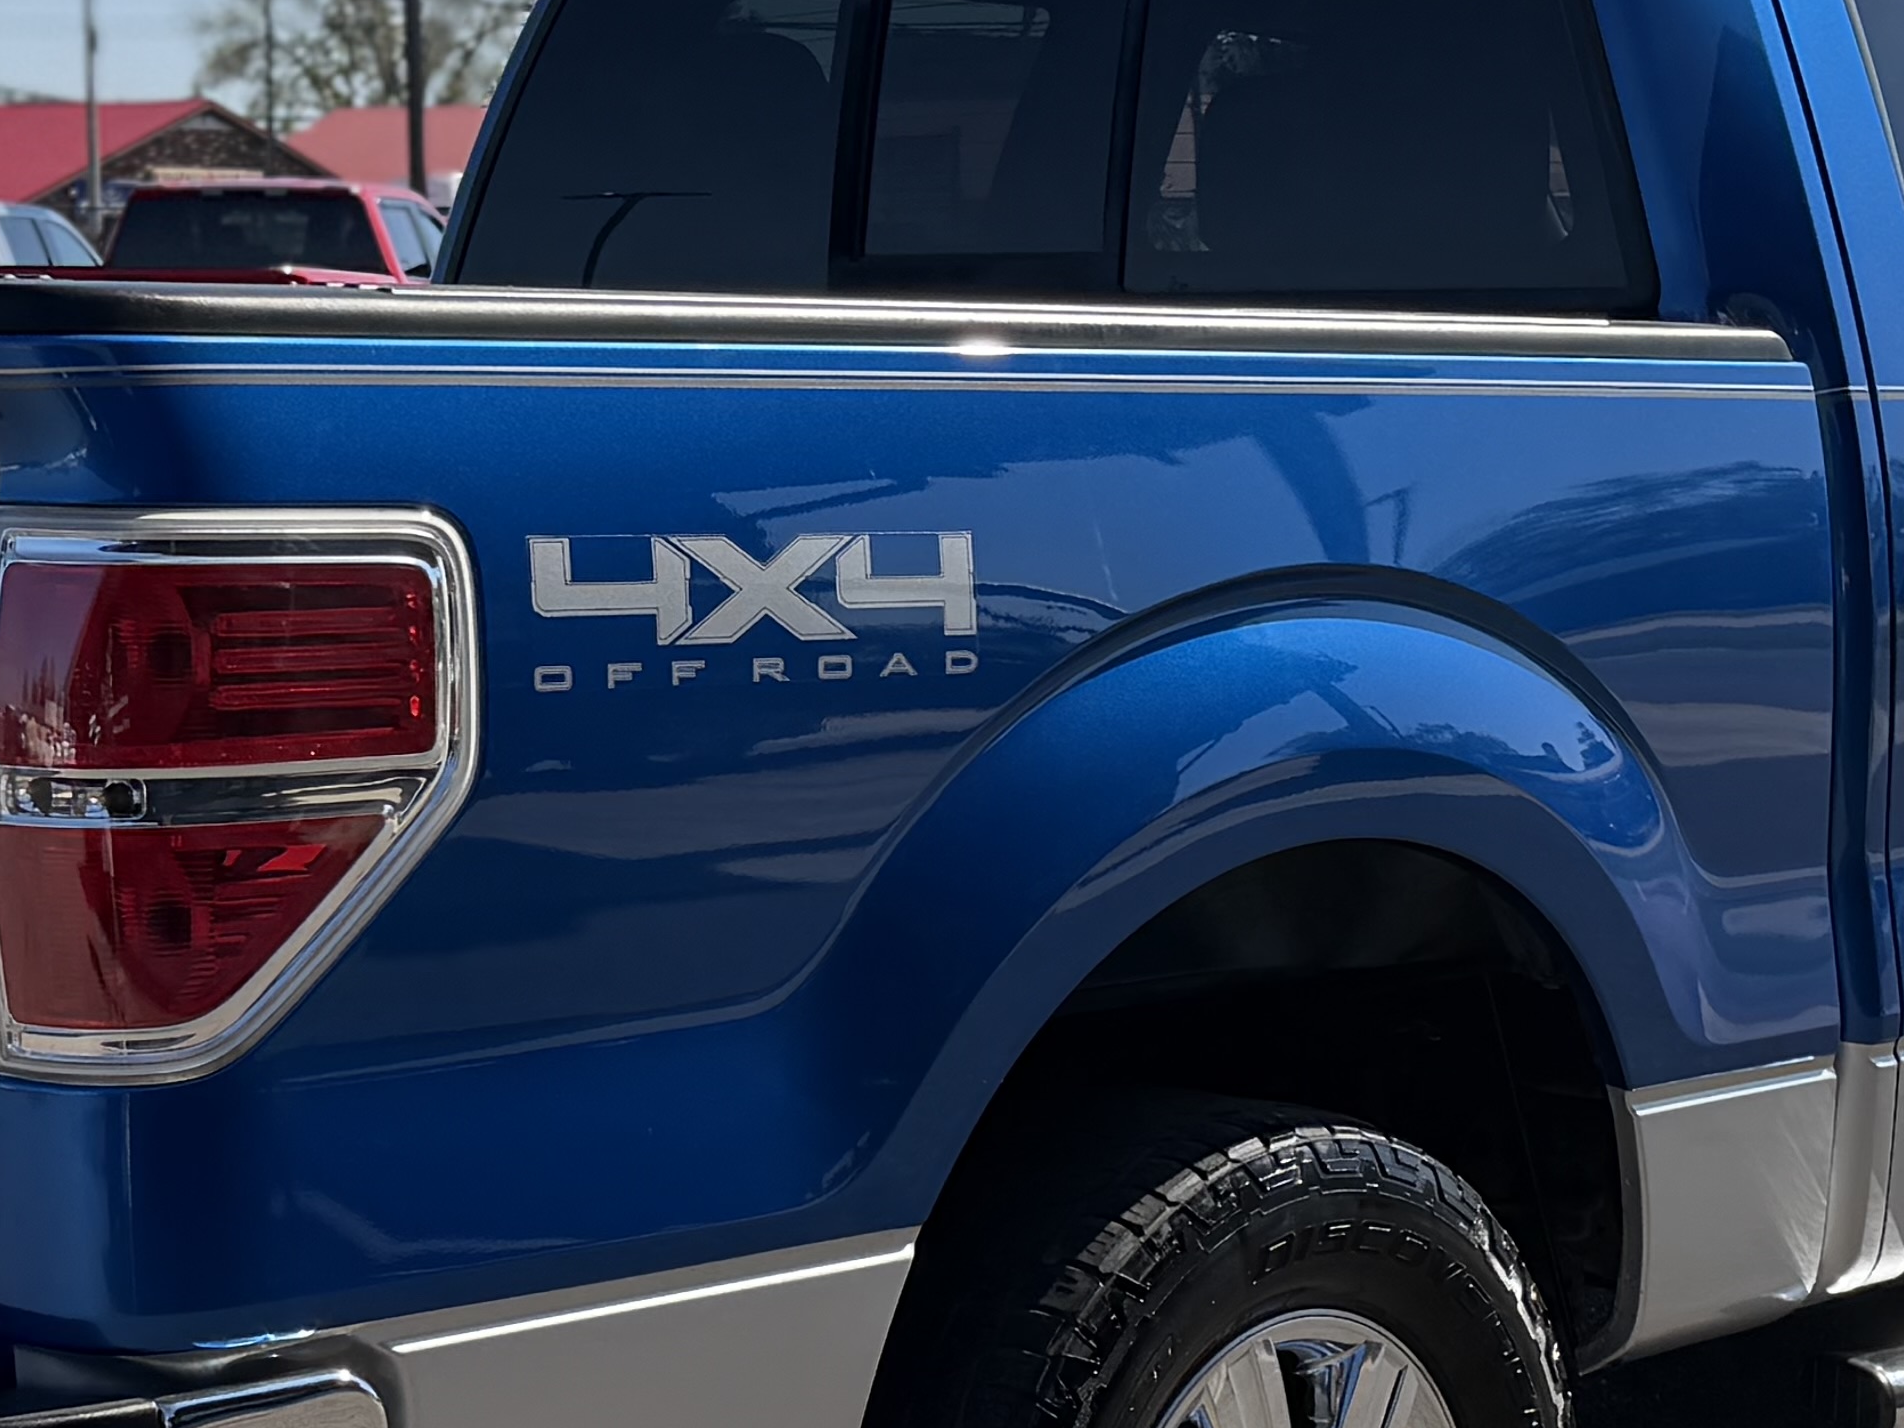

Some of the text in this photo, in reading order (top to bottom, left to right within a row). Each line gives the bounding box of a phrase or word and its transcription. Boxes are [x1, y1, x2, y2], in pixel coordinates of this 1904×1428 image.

[526, 531, 978, 647] 4X4
[534, 649, 979, 693] OFF ROAD
